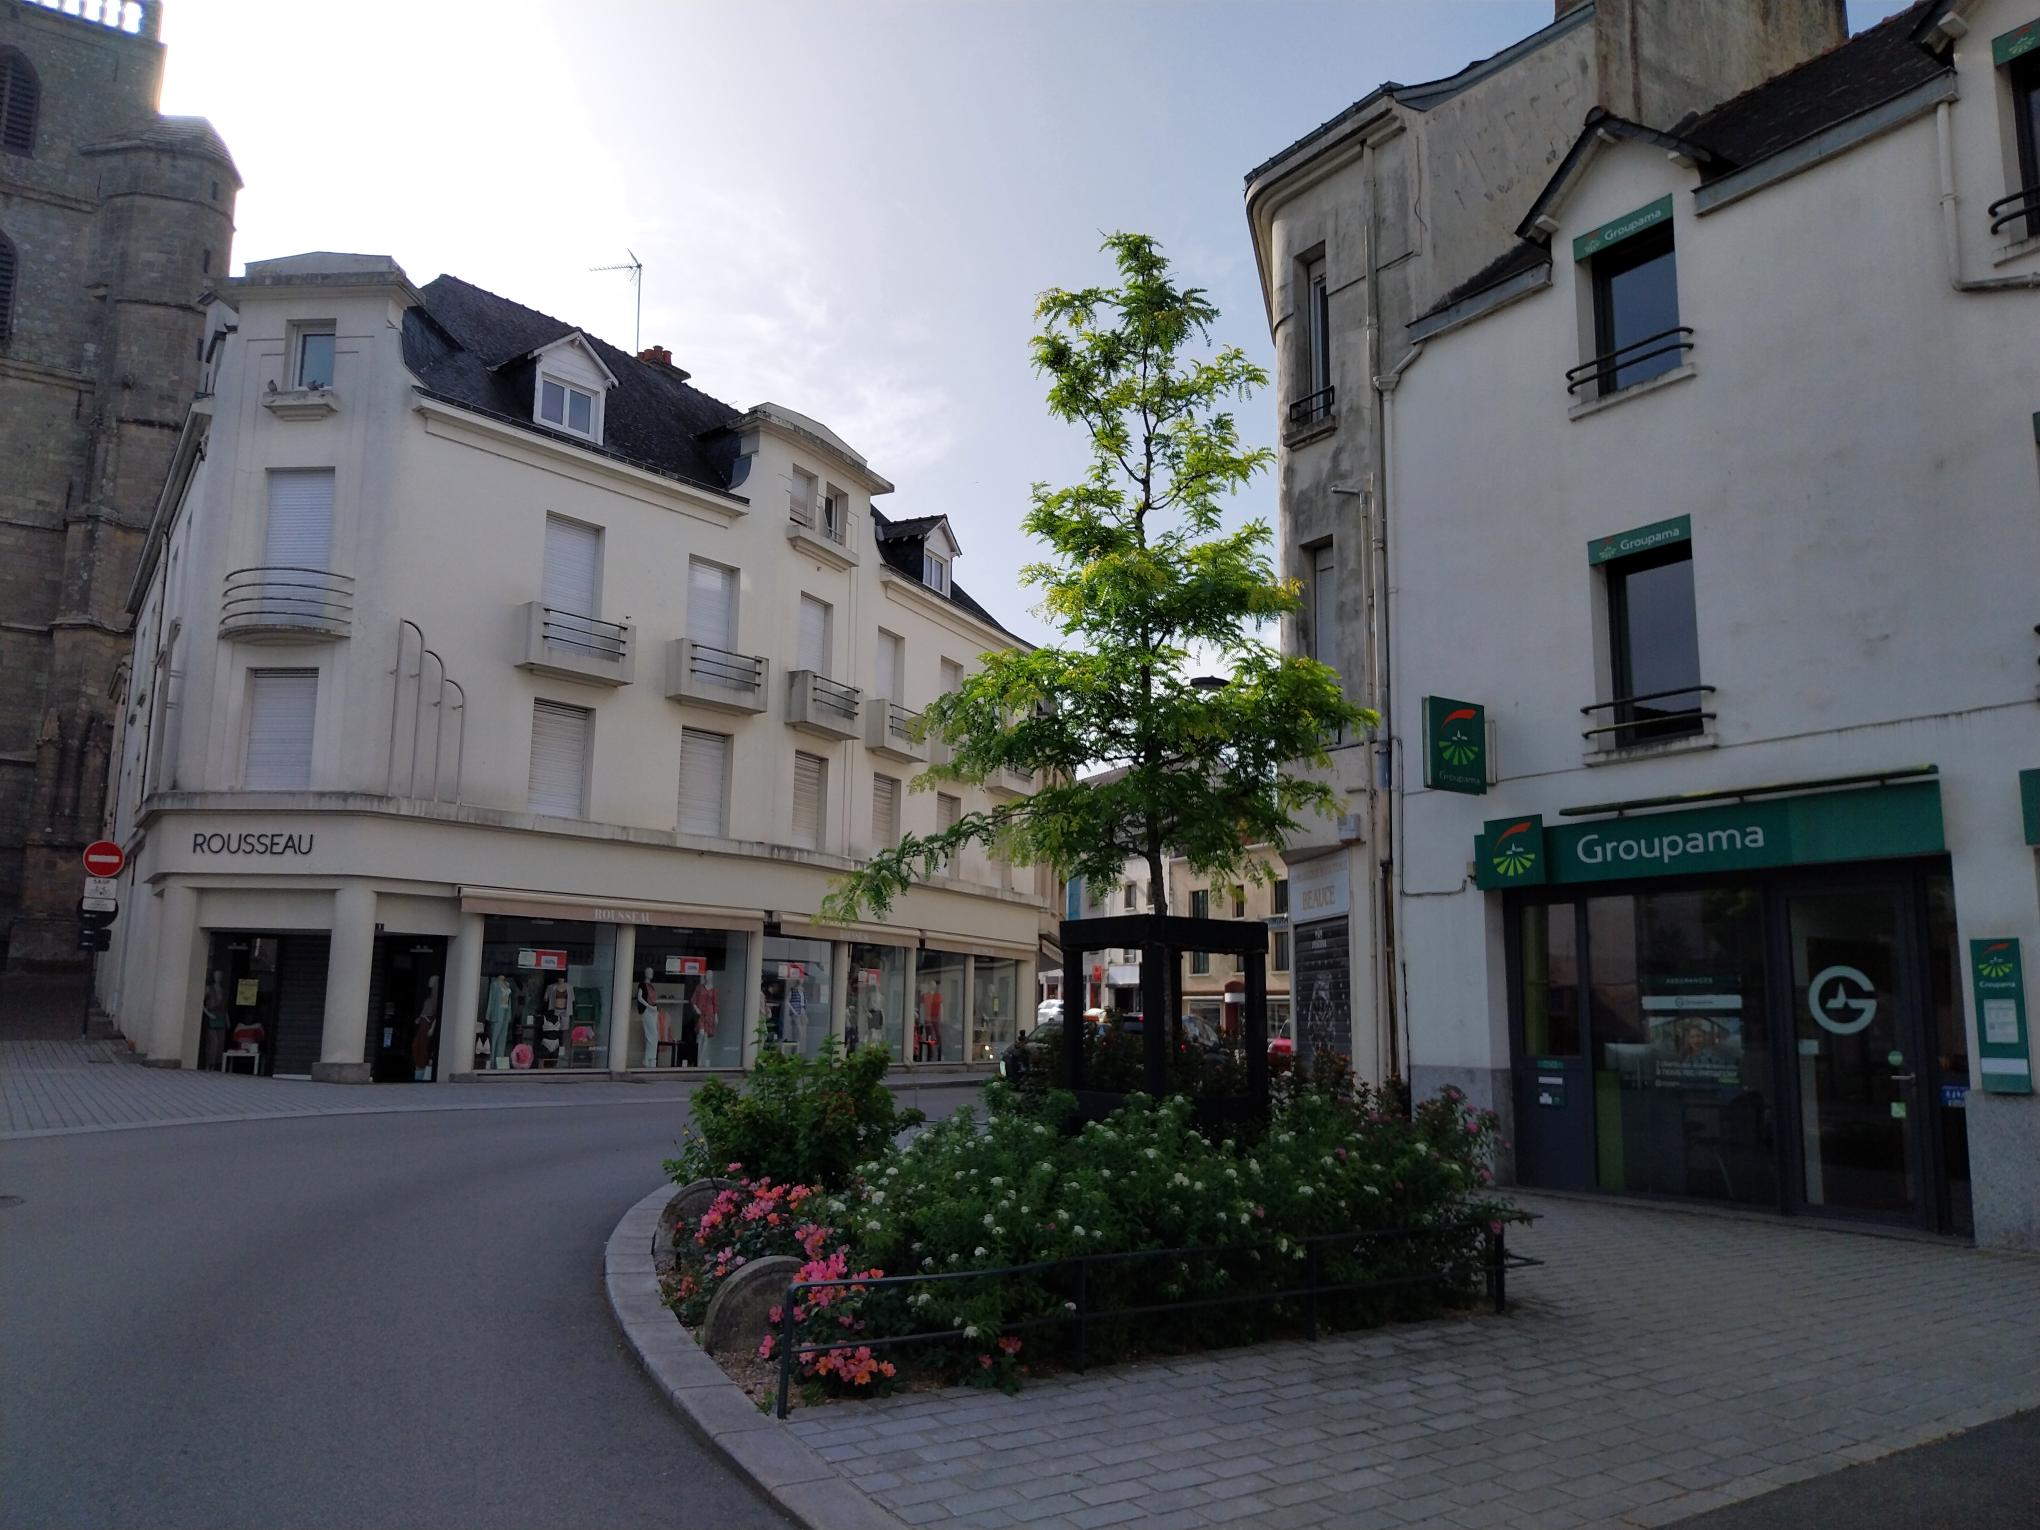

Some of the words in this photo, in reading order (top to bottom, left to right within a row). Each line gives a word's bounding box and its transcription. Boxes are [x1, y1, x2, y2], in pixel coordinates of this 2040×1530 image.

[1604, 209, 1662, 241] Groupama
[1620, 527, 1680, 551] Groupama
[1439, 769, 1482, 785] Groupama
[192, 832, 314, 855] ROUSSEAU
[1576, 824, 1765, 864] Groupama
[594, 907, 654, 924] ROUSSEAU
